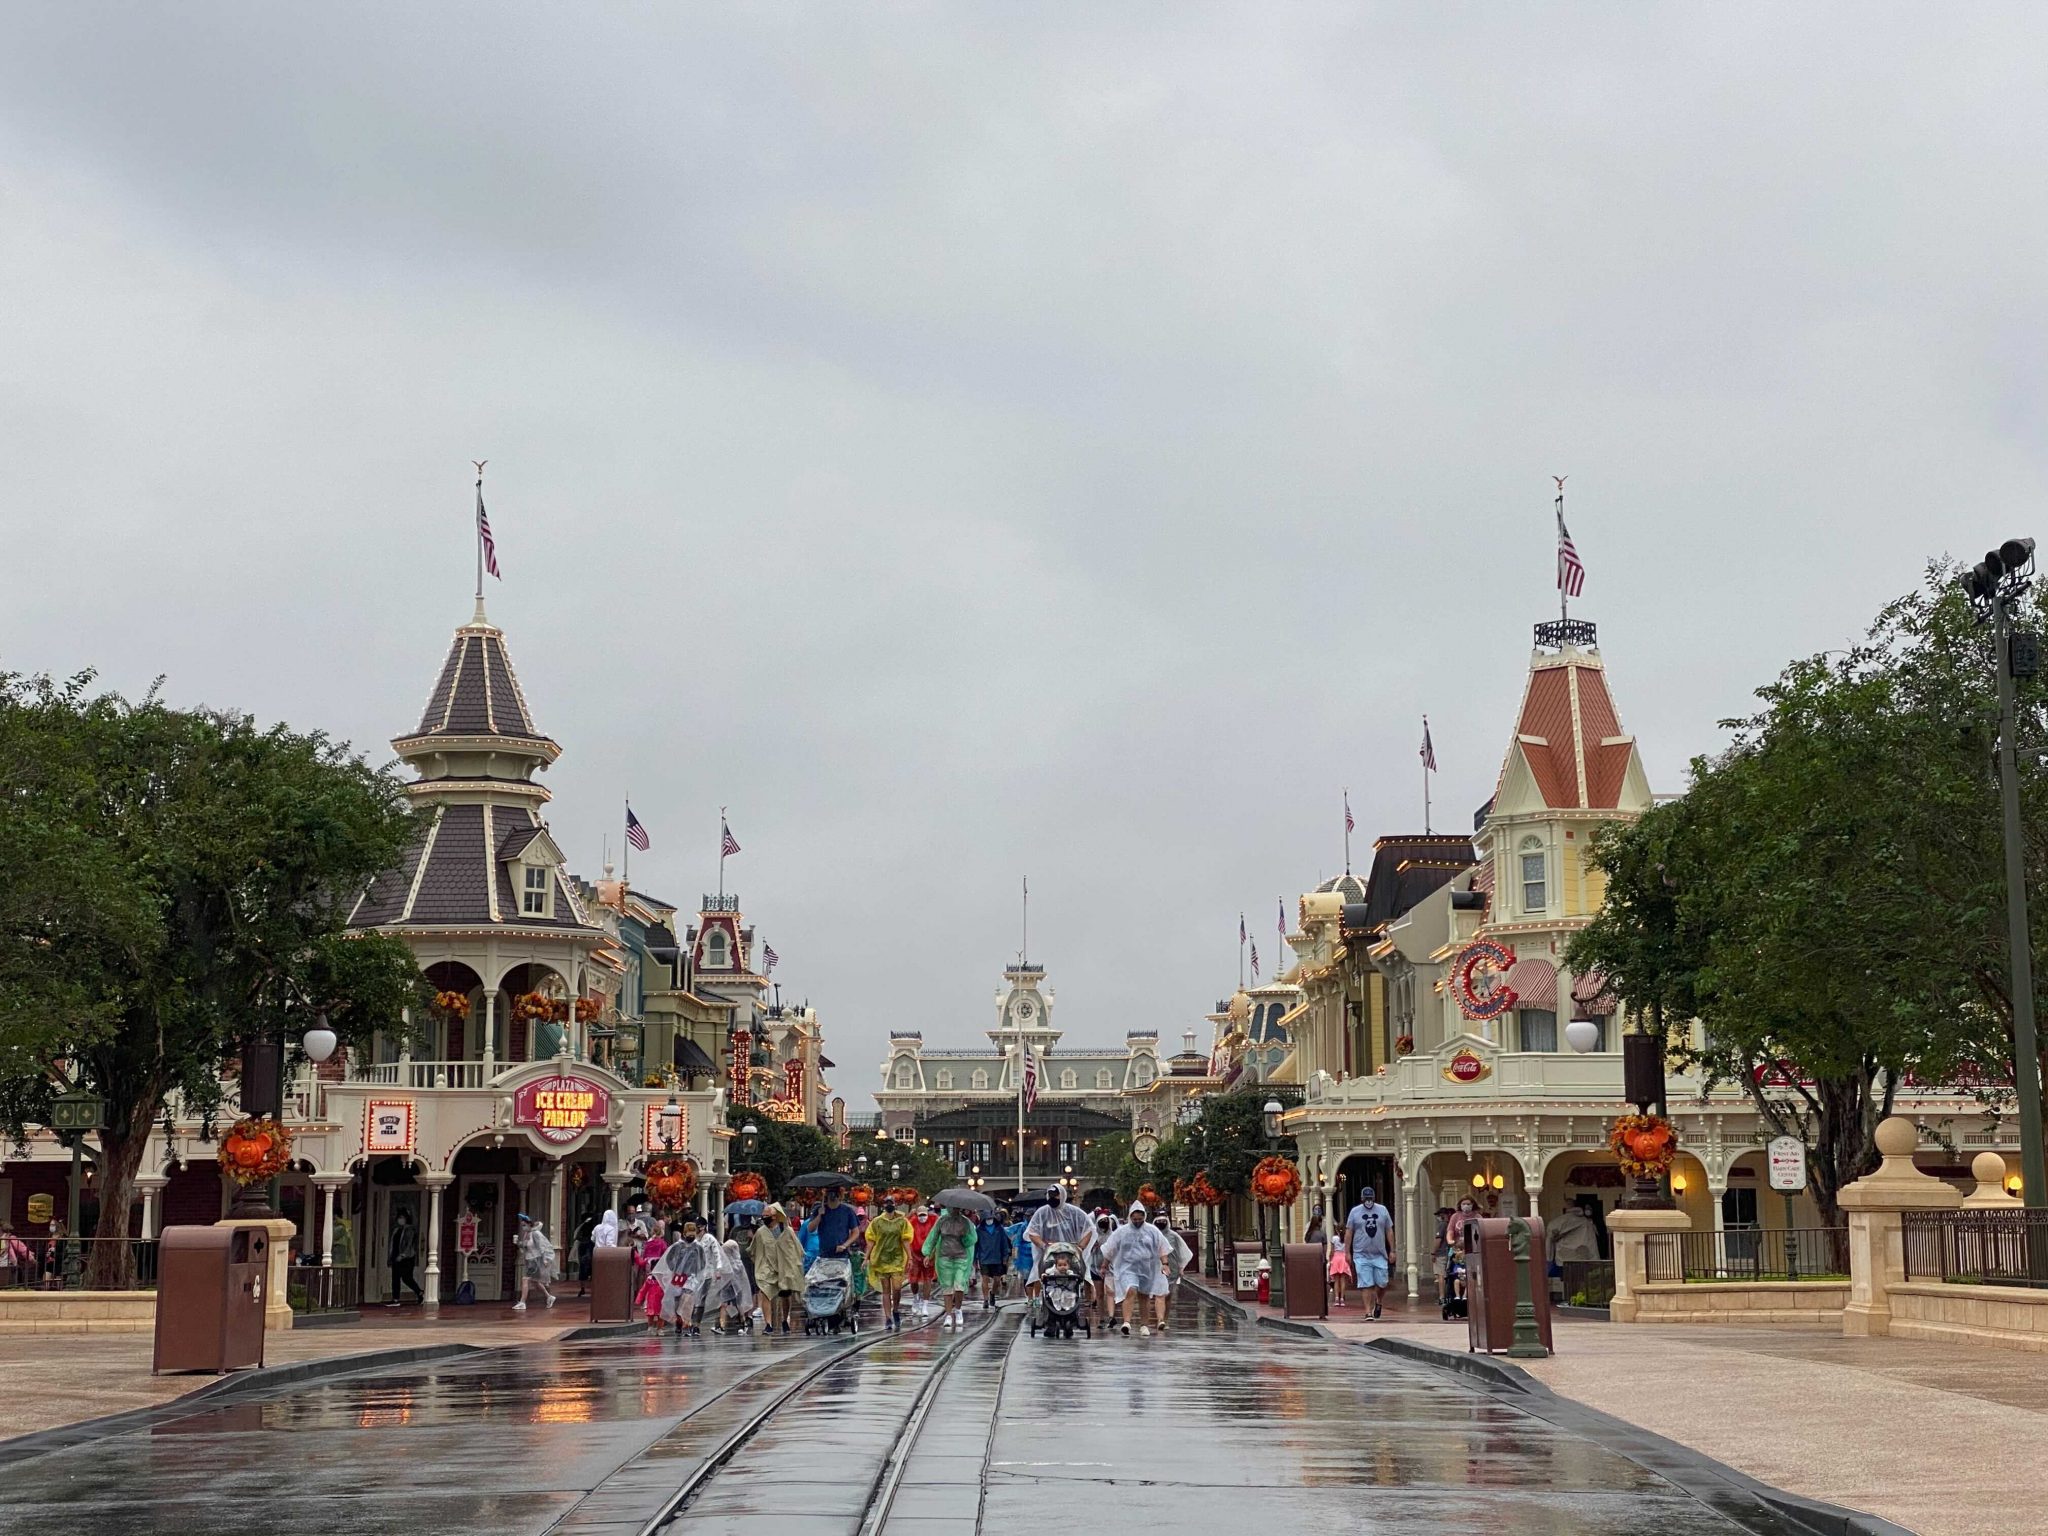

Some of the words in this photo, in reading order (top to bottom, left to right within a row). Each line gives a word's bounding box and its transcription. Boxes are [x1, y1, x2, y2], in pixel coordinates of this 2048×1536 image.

[552, 1080, 575, 1091] PLAZA
[535, 1092, 555, 1109] ICE
[556, 1092, 594, 1110] CREAM
